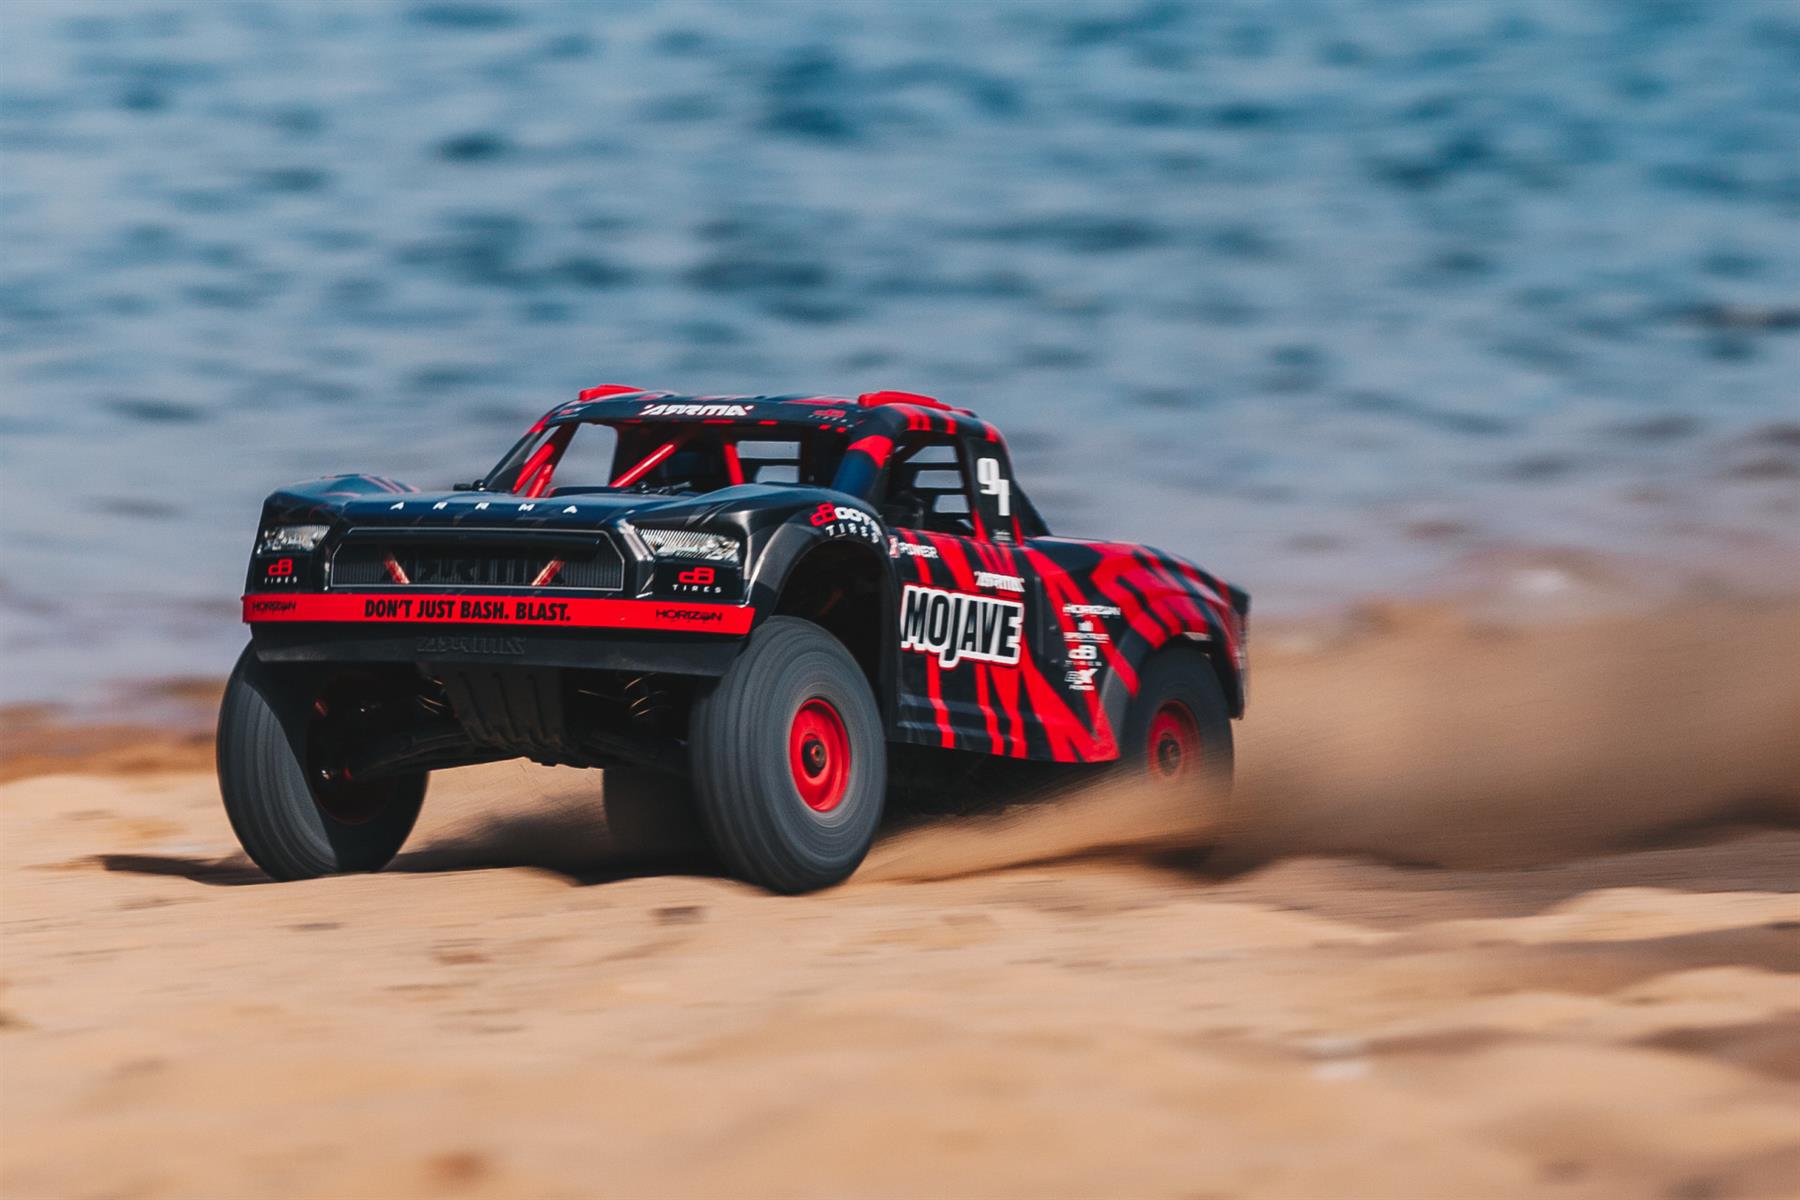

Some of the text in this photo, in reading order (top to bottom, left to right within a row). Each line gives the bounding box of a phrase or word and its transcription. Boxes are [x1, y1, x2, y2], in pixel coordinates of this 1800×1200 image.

[825, 522, 880, 543] TIRES
[672, 584, 722, 594] TIRES
[364, 600, 571, 621] DON'T JUST BASH. BLAST.
[655, 608, 723, 622] HORIZON
[901, 587, 1022, 664] MOJAVE
